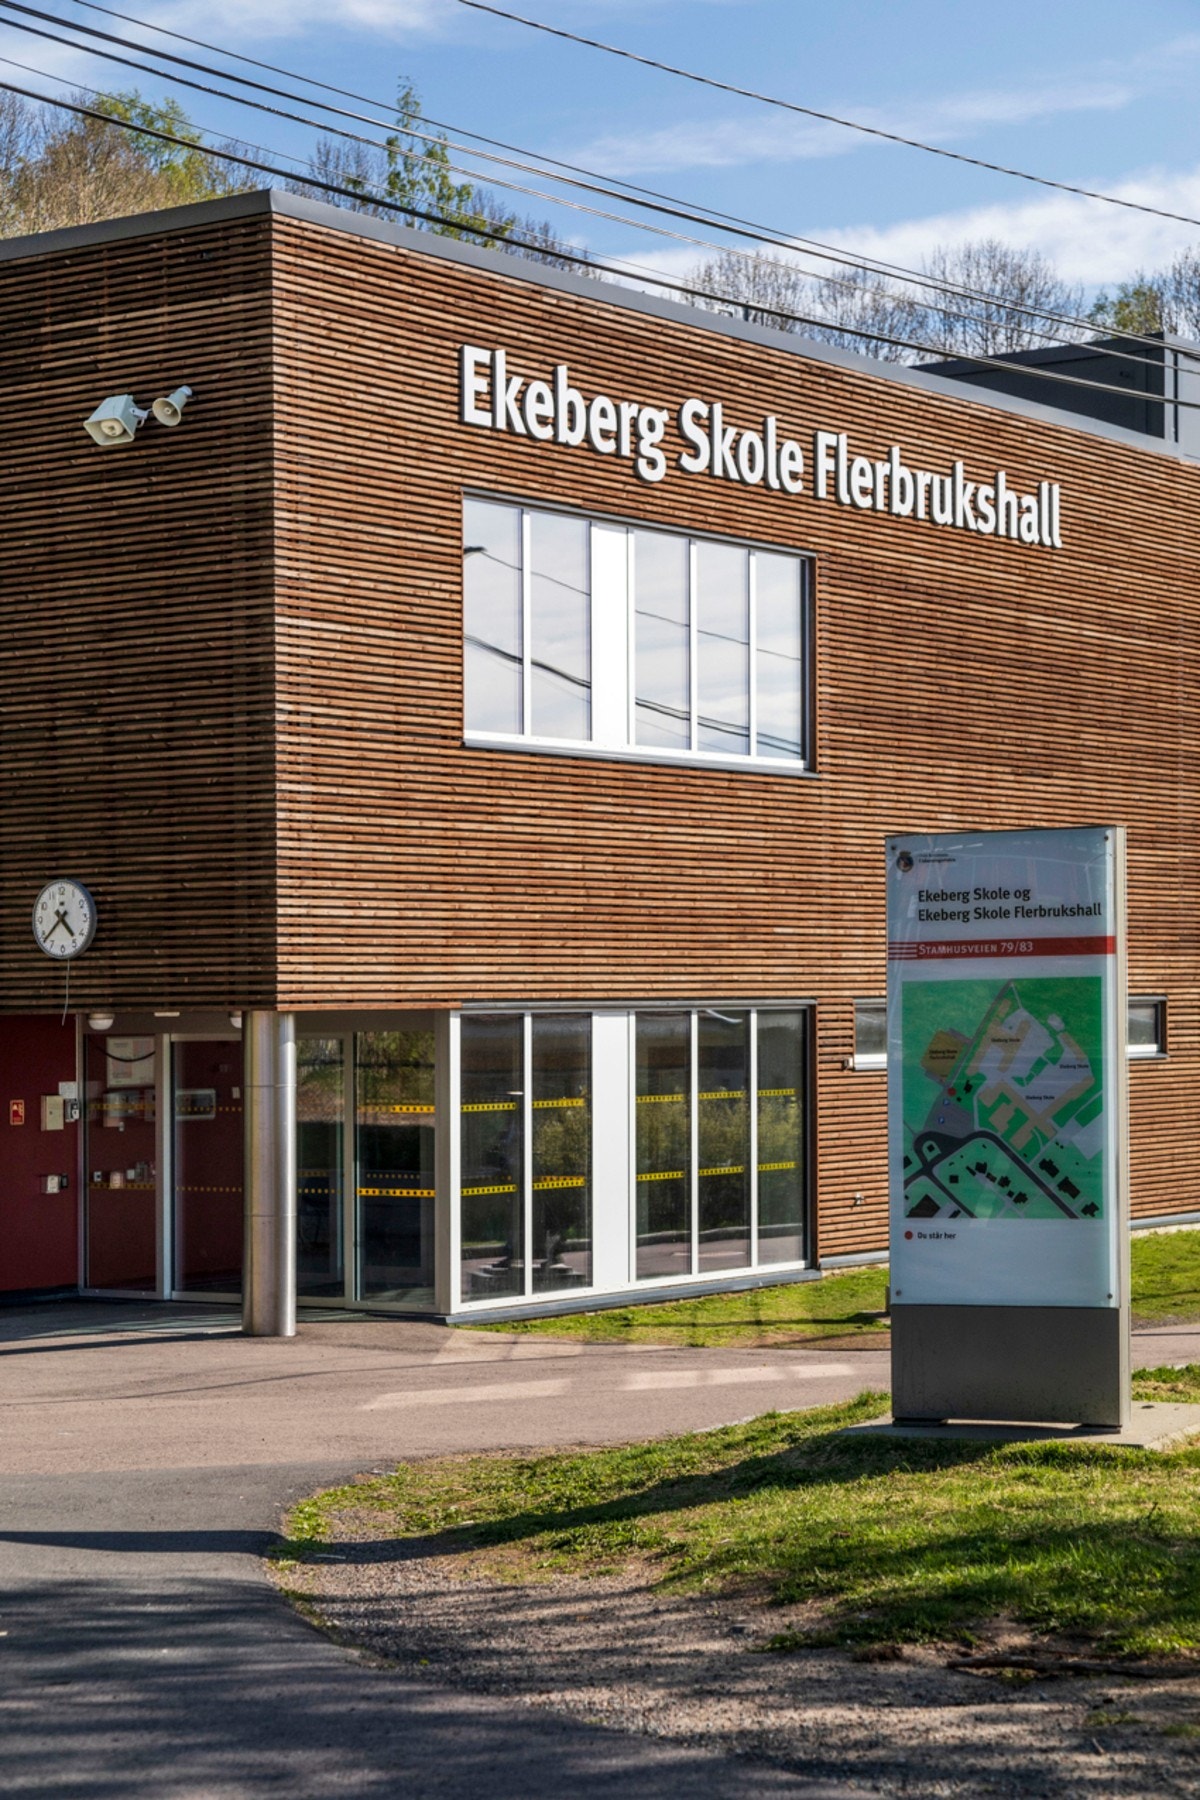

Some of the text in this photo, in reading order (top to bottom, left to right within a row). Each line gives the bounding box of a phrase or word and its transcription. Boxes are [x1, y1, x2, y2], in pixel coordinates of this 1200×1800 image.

[459, 344, 1063, 549] Ekeberg Skole Flerbrukshall
[58, 886, 66, 895] 12
[918, 887, 1031, 904] Ekeberg Skole og
[78, 899, 84, 909] 2
[918, 902, 1102, 923] Ekeberg Skole Flerbrukshall
[82, 913, 88, 923] 3
[78, 928, 85, 937] 4
[60, 944, 66, 953] 6
[1000, 941, 1033, 953] 79/83
